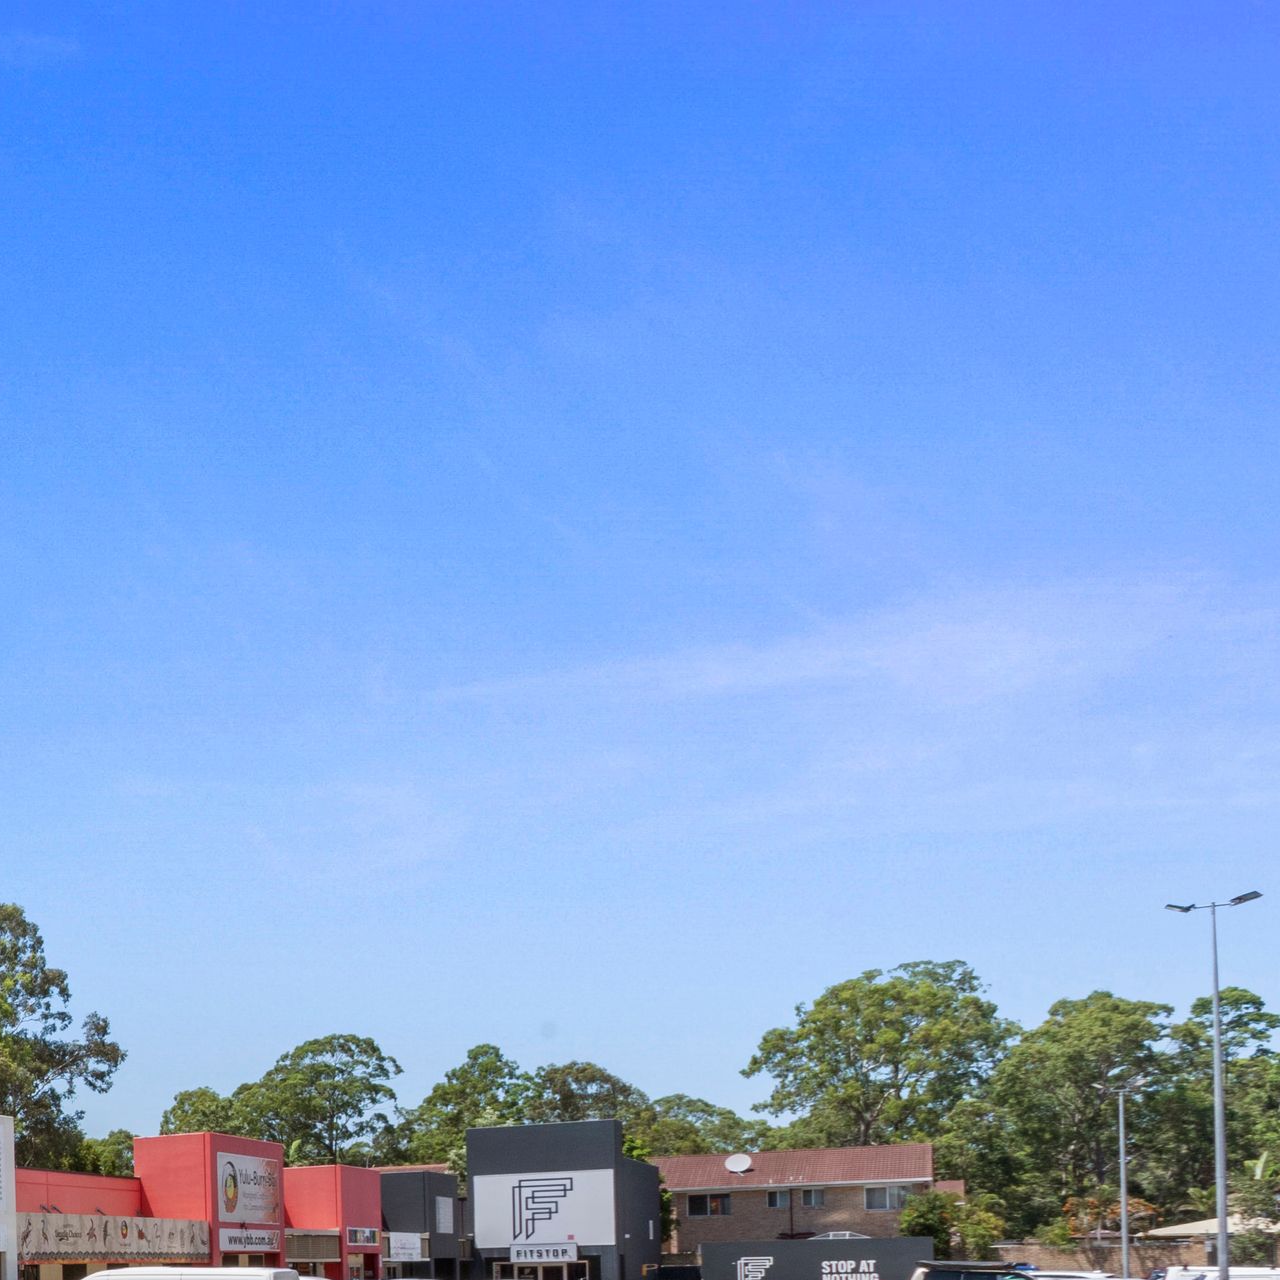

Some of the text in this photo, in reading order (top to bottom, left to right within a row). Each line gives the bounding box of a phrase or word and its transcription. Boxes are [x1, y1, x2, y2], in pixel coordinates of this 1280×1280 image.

[516, 1248, 568, 1260] FITSTOP
[821, 1260, 877, 1273] STOP AT
